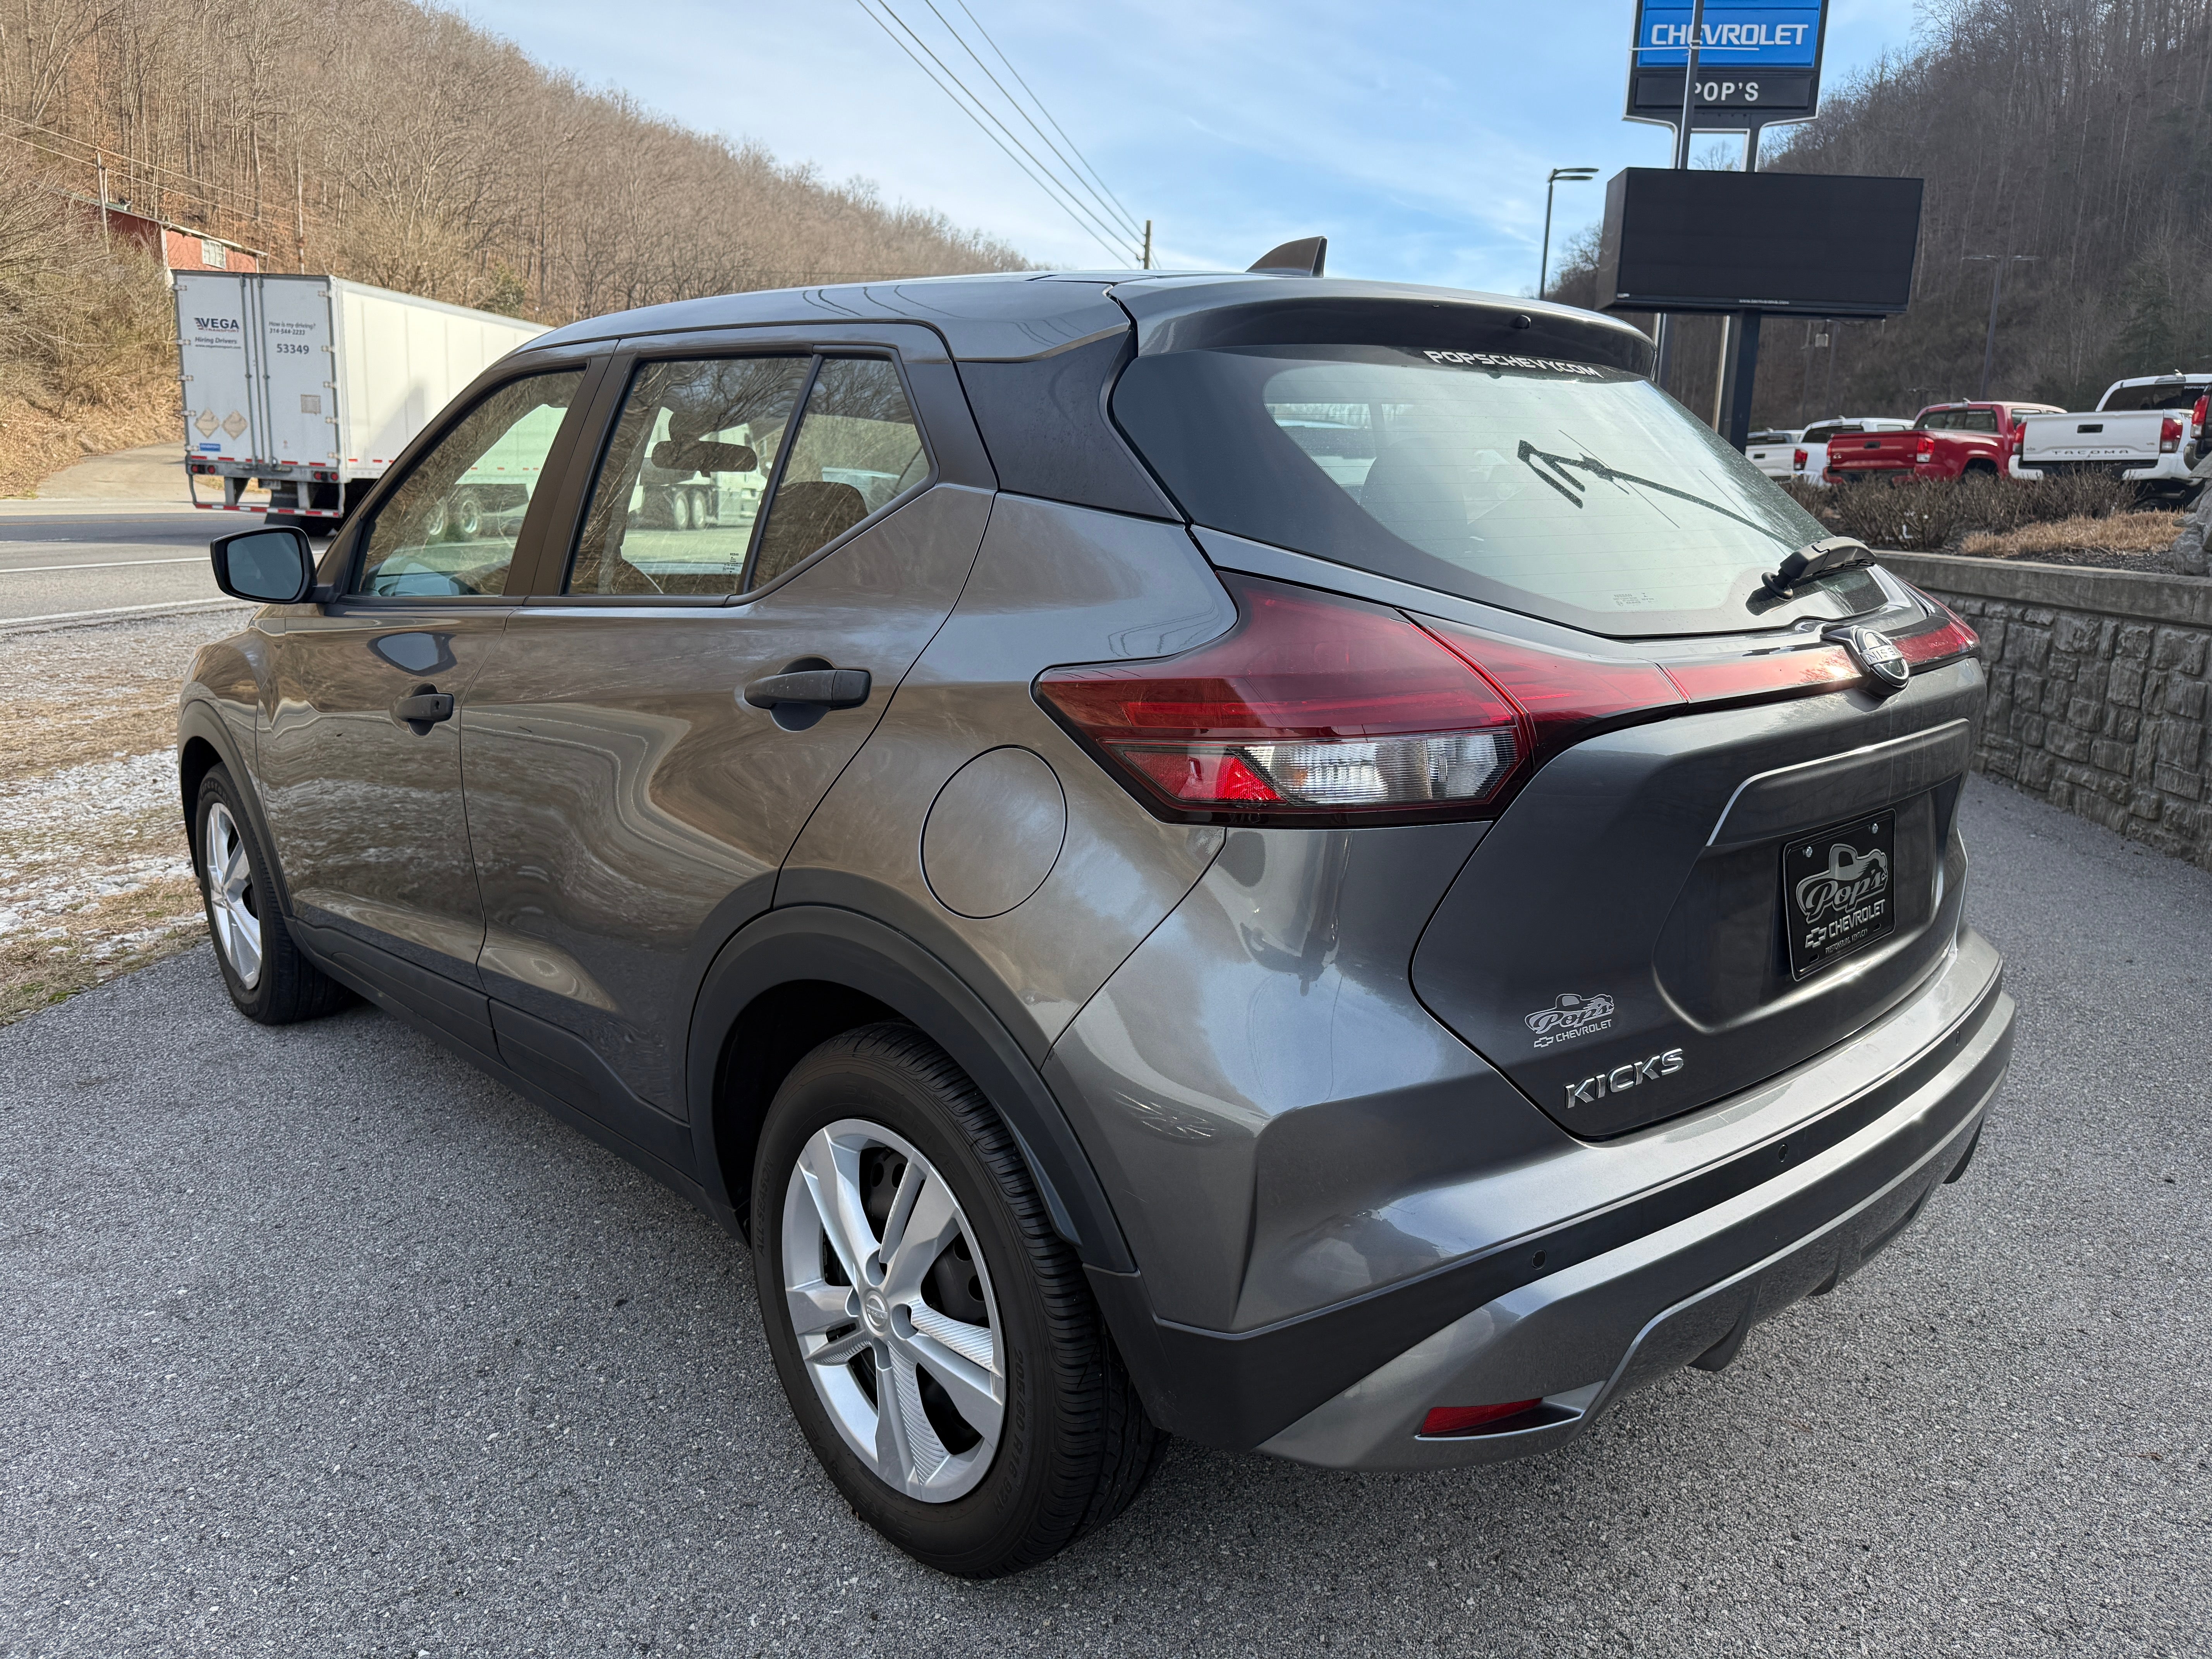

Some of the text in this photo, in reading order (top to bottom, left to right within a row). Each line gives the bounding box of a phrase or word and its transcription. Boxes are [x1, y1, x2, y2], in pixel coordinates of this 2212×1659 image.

[200, 318, 239, 329] VEGA
[276, 343, 309, 355] 53349
[1423, 350, 1604, 378] POPSCHEVY.COM
[1805, 869, 1884, 916] Pop's
[1829, 899, 1885, 938] CHEVROLET
[1555, 1019, 1612, 1042] CHEVROLET
[1564, 1048, 1684, 1109] KICKS
[756, 1154, 774, 1259] ALL-SEASON
[1013, 1346, 1026, 1432] 205/60
